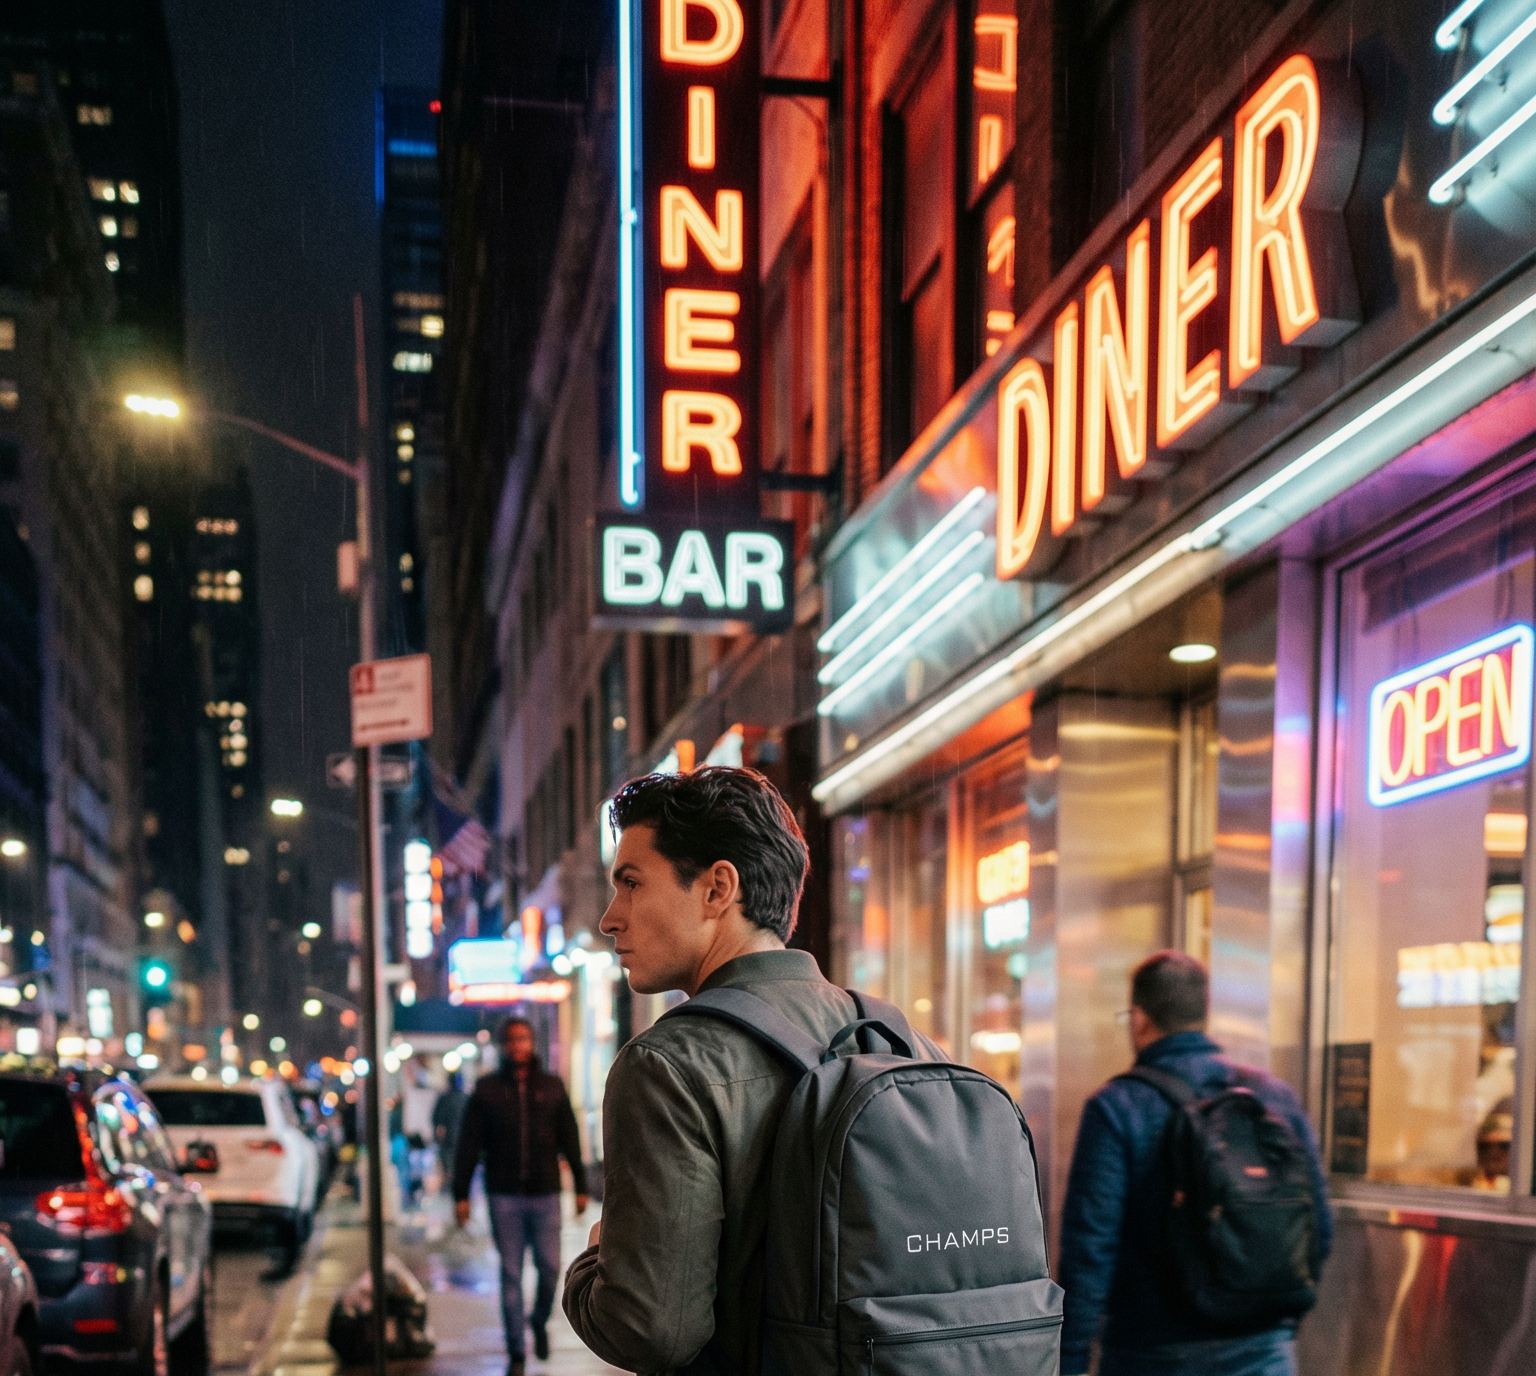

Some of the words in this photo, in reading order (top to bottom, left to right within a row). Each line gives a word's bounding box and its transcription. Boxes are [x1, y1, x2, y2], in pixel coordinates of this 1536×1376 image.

[660, 0, 744, 475] DINER
[996, 54, 1320, 581] DINER
[603, 526, 784, 611] BAR
[1380, 642, 1526, 786] OPEN
[907, 1227, 1009, 1253] CHAMPS
